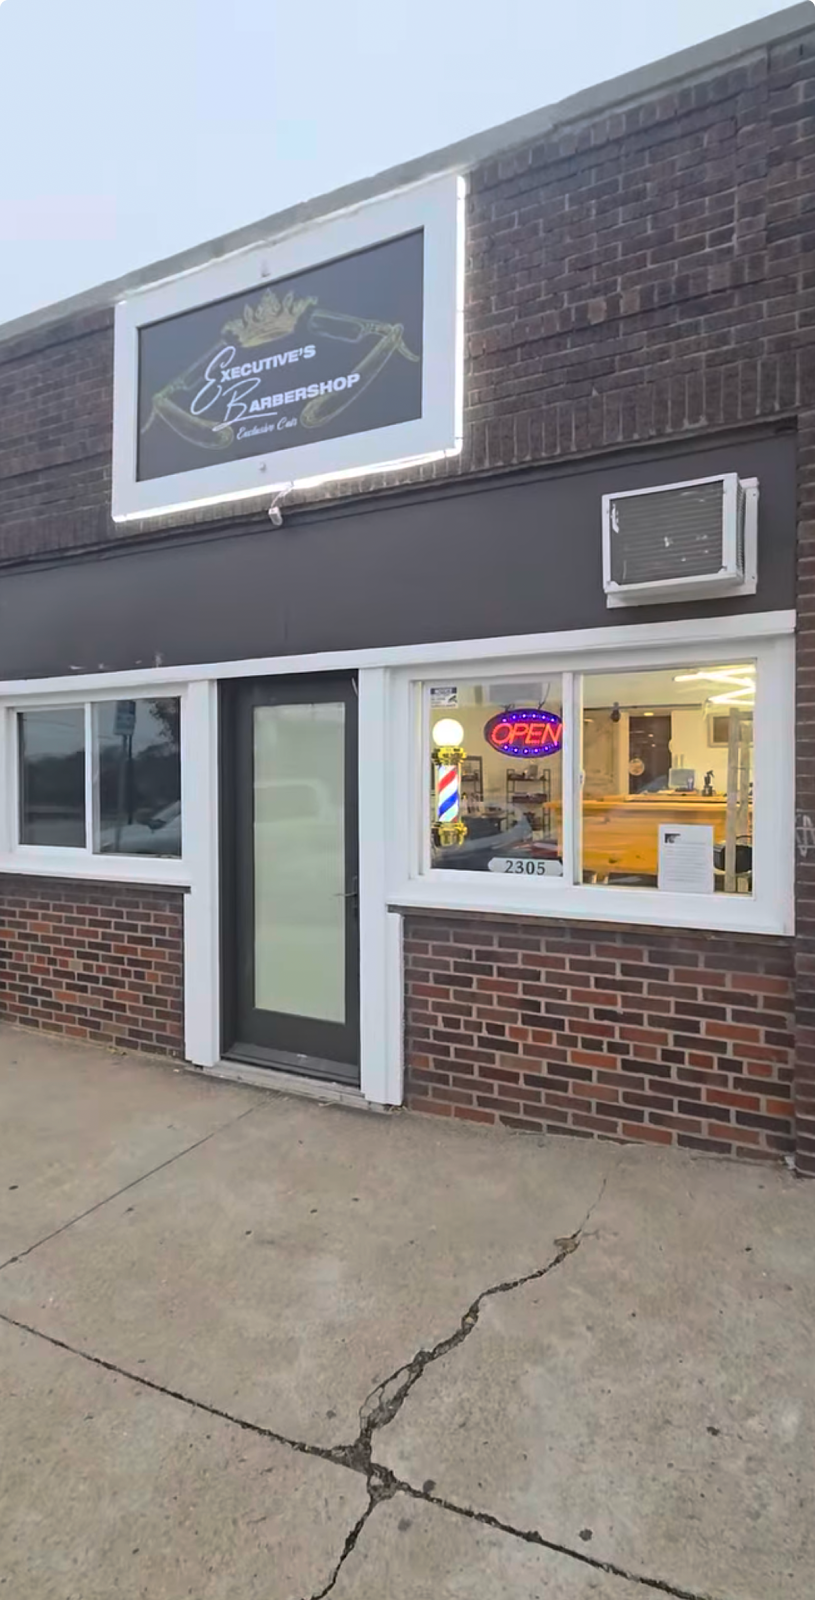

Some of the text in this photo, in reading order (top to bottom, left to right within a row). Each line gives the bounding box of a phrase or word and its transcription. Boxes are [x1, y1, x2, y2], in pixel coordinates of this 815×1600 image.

[191, 345, 316, 415] EXECUTIVE'S
[212, 373, 360, 431] BARBERSHOP
[491, 723, 563, 746] OPEN
[505, 860, 546, 875] 2305
